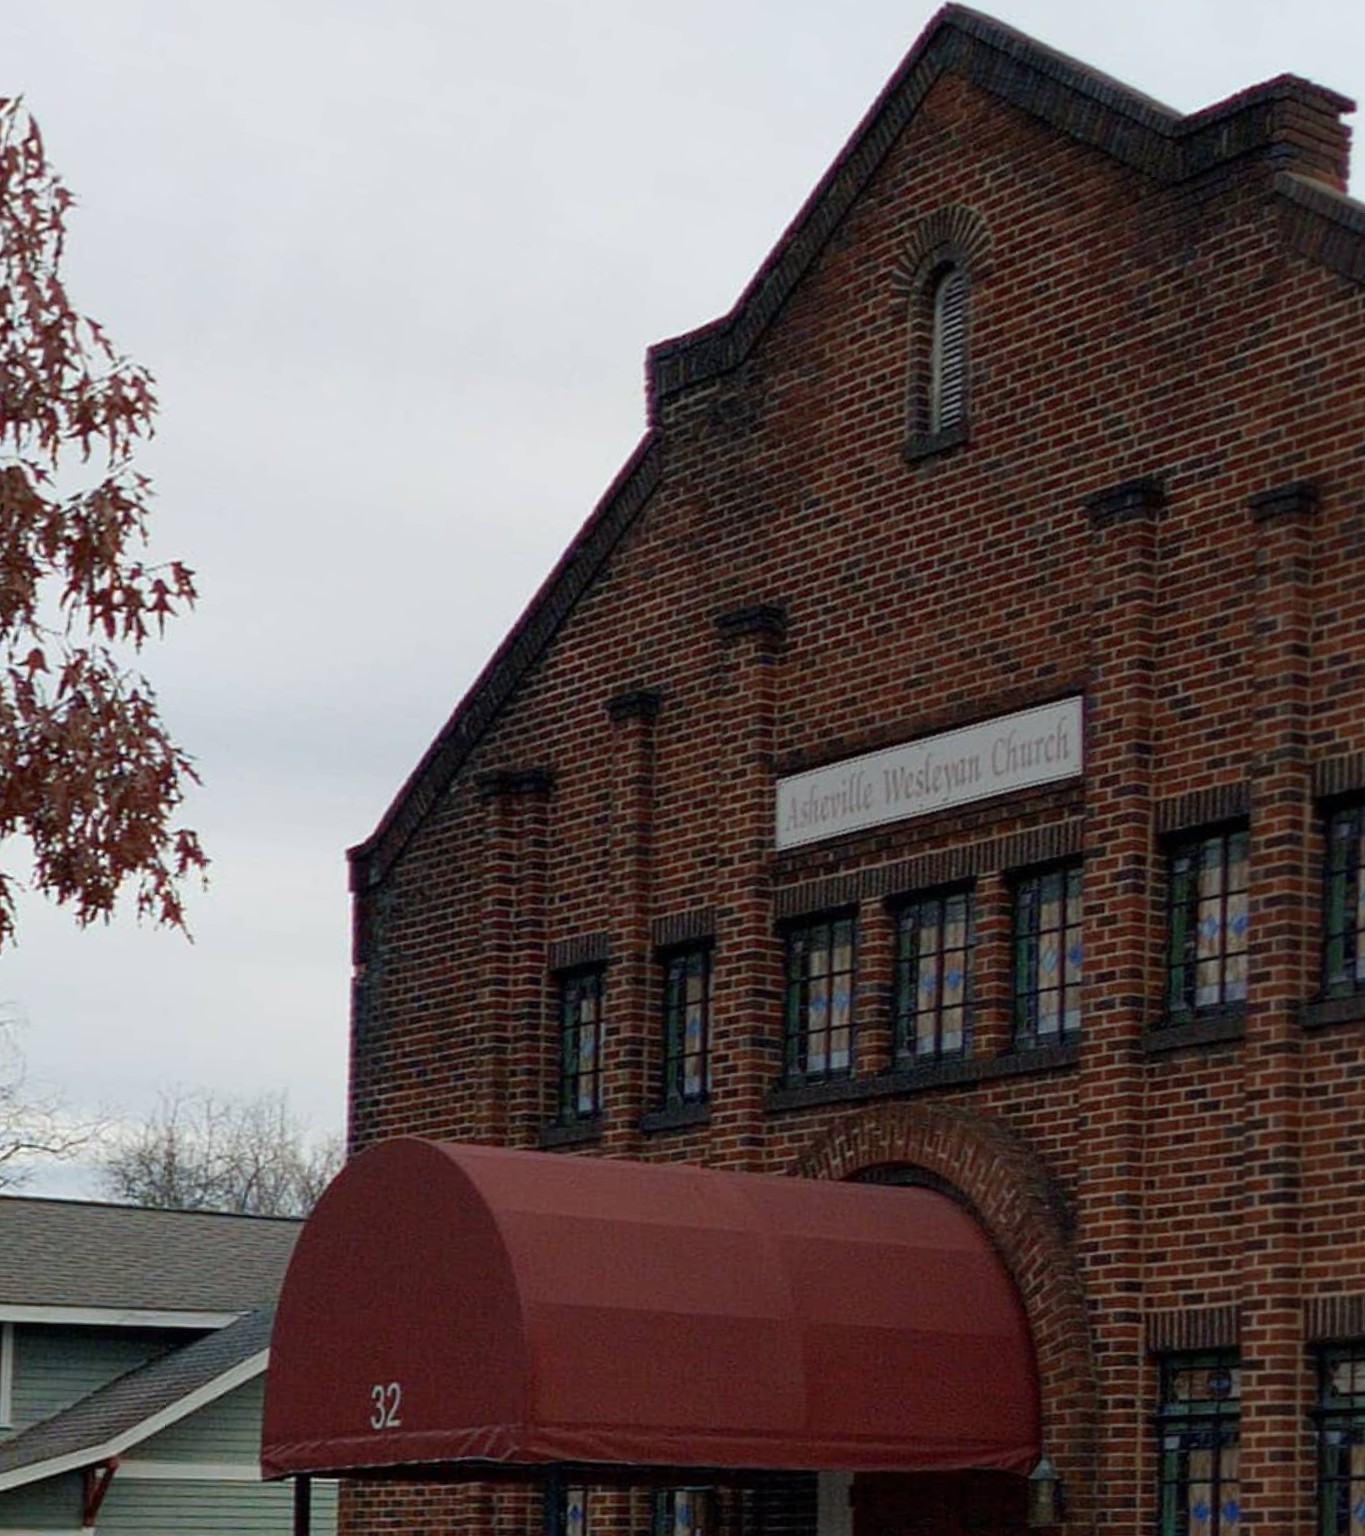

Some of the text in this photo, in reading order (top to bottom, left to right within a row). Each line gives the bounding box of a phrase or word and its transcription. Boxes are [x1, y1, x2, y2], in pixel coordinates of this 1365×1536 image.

[785, 716, 1069, 831] Asheville Wesleyan Church
[371, 1382, 401, 1430] 32
